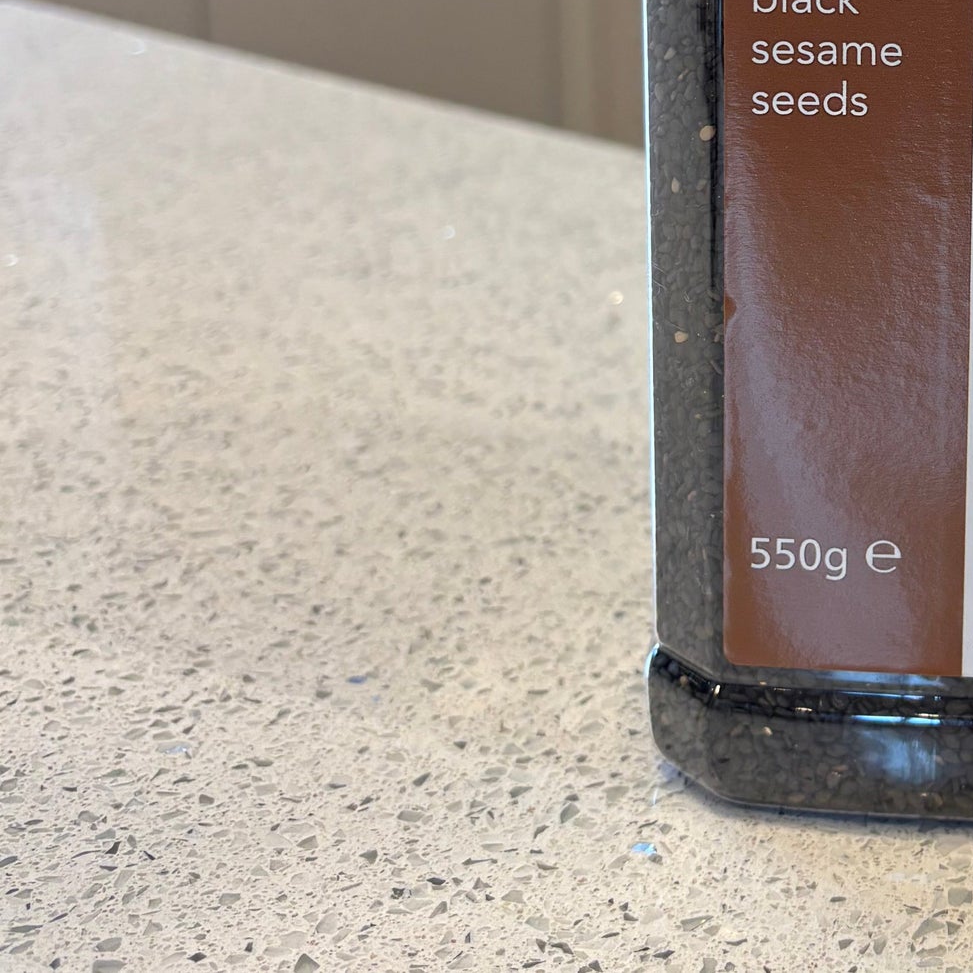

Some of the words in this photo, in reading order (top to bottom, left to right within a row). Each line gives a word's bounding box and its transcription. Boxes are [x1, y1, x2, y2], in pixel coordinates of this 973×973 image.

[751, 40, 903, 67] sesame
[751, 80, 868, 116] seeds
[750, 537, 848, 581] 550g
